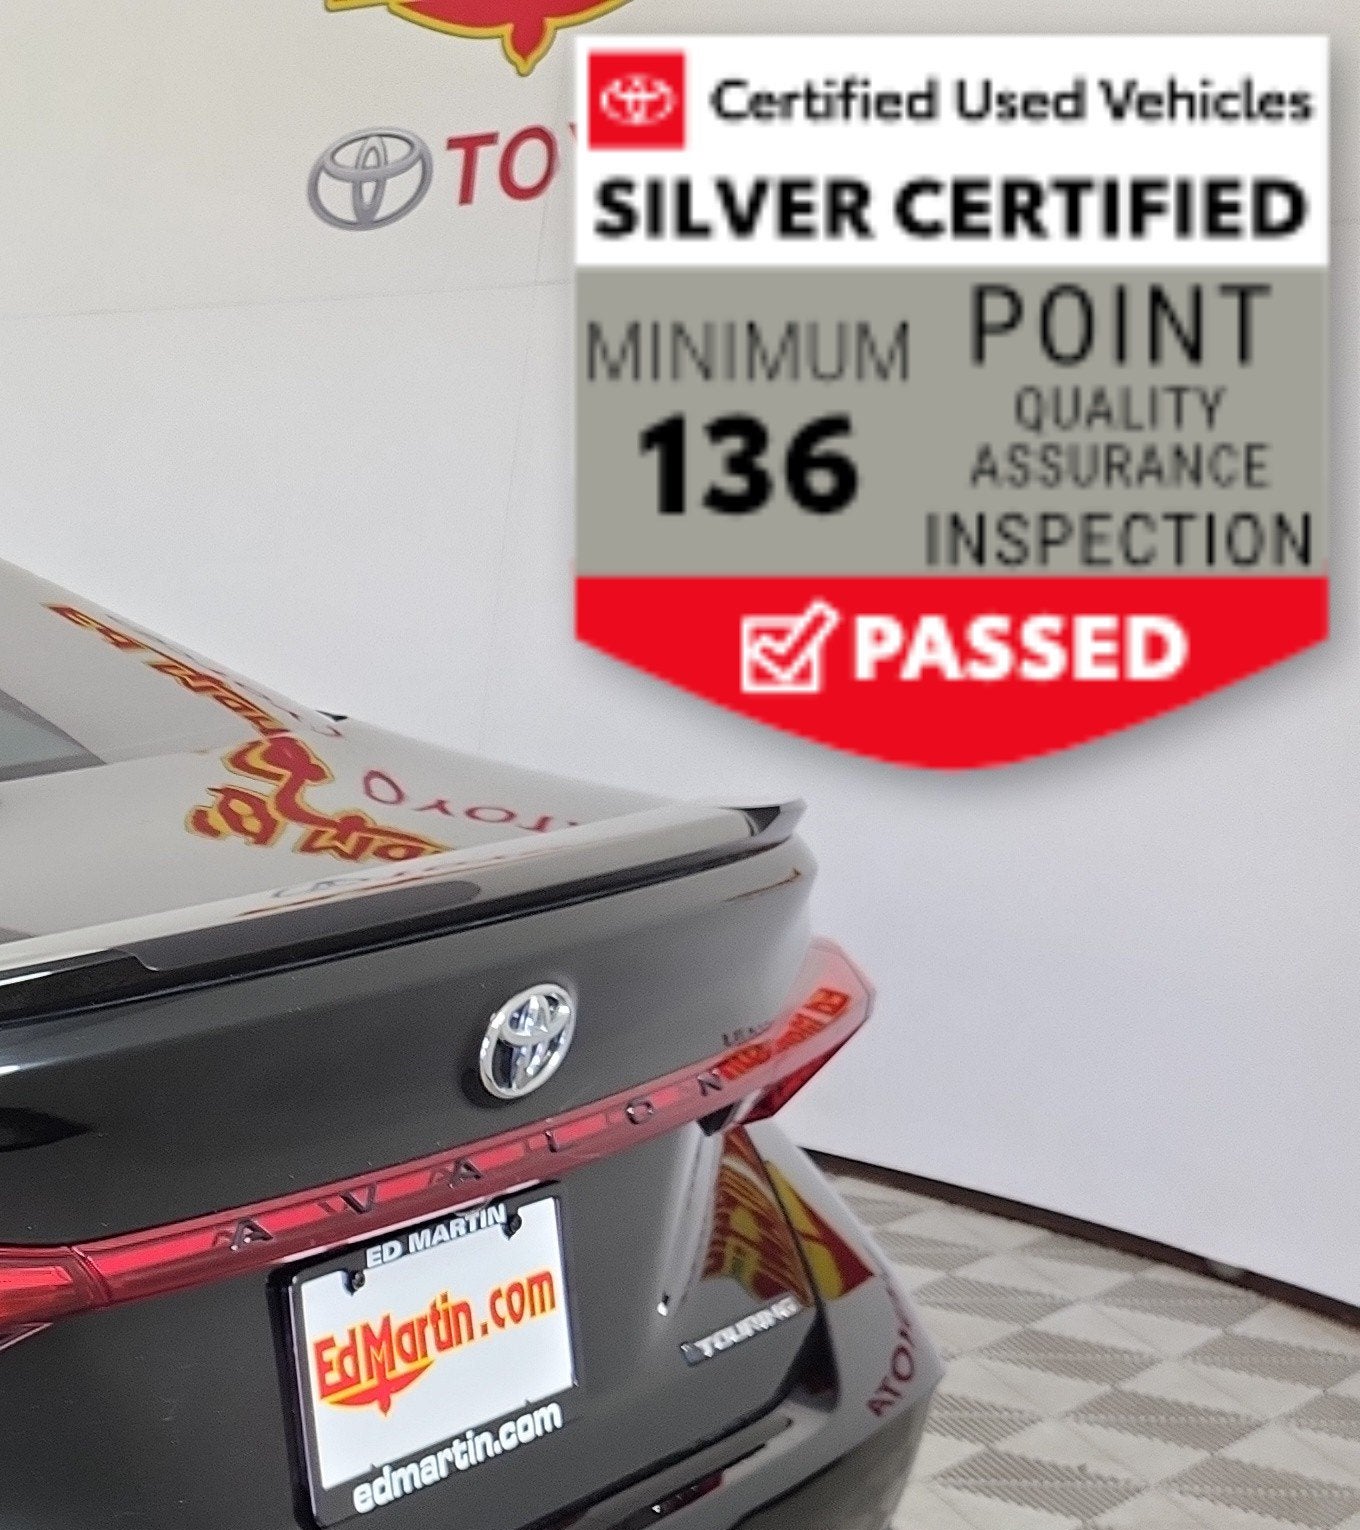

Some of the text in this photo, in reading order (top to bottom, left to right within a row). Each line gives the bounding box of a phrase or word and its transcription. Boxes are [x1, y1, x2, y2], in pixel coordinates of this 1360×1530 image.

[446, 124, 577, 206] TO
[229, 1068, 723, 1251] AVALON
[365, 1203, 507, 1269] ED MARTIN
[313, 1270, 556, 1397] EdMartin.com
[693, 1296, 801, 1358] TOURING
[352, 1402, 563, 1515] edmartin.com
